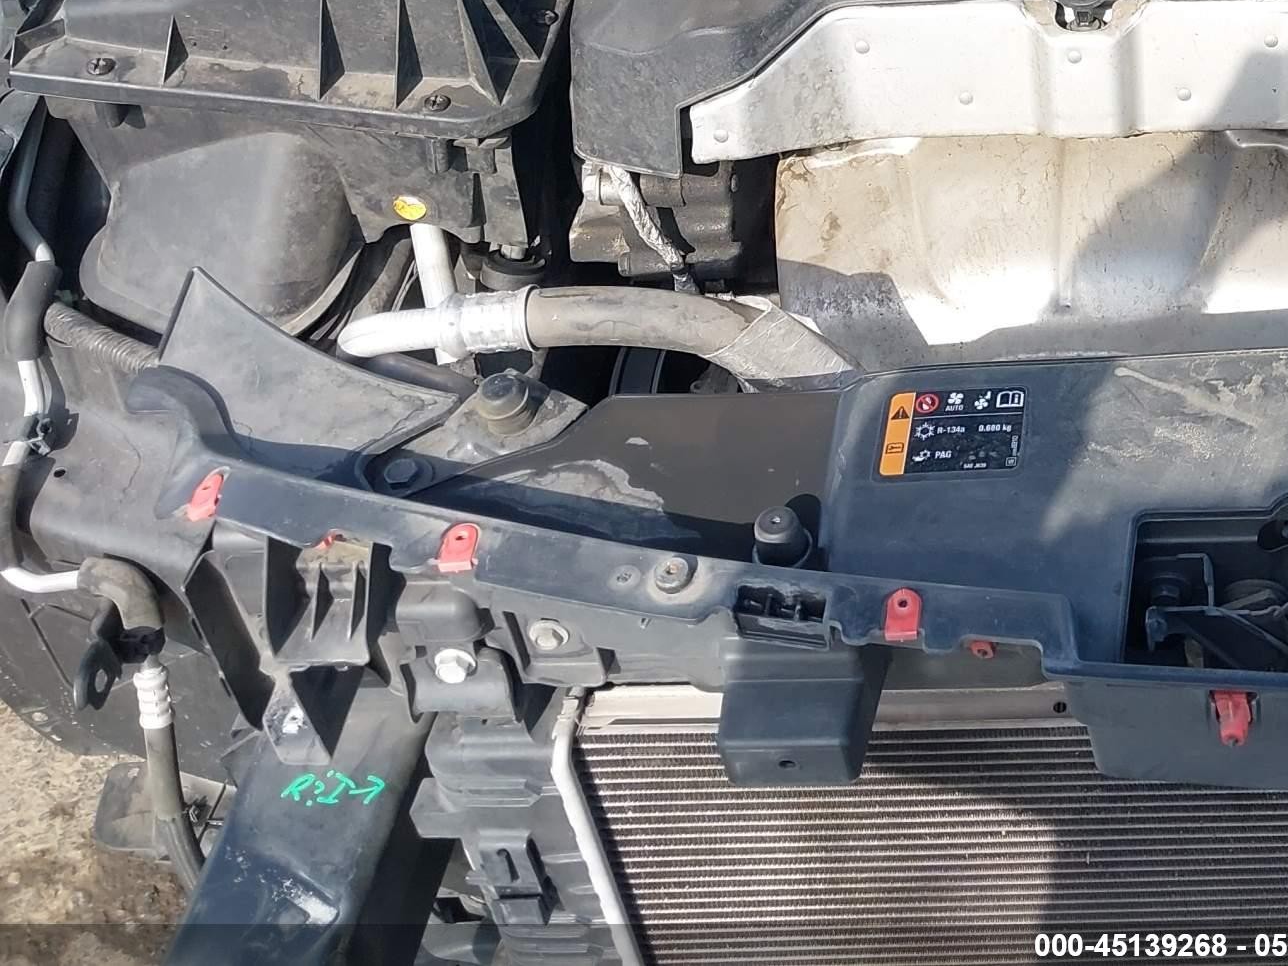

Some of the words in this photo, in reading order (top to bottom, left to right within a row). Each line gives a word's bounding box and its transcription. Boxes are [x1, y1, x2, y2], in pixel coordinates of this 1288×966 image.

[945, 404, 964, 412] AUTO
[936, 425, 966, 434] R-134a
[1001, 424, 1012, 433] kg
[934, 450, 952, 459] PAG
